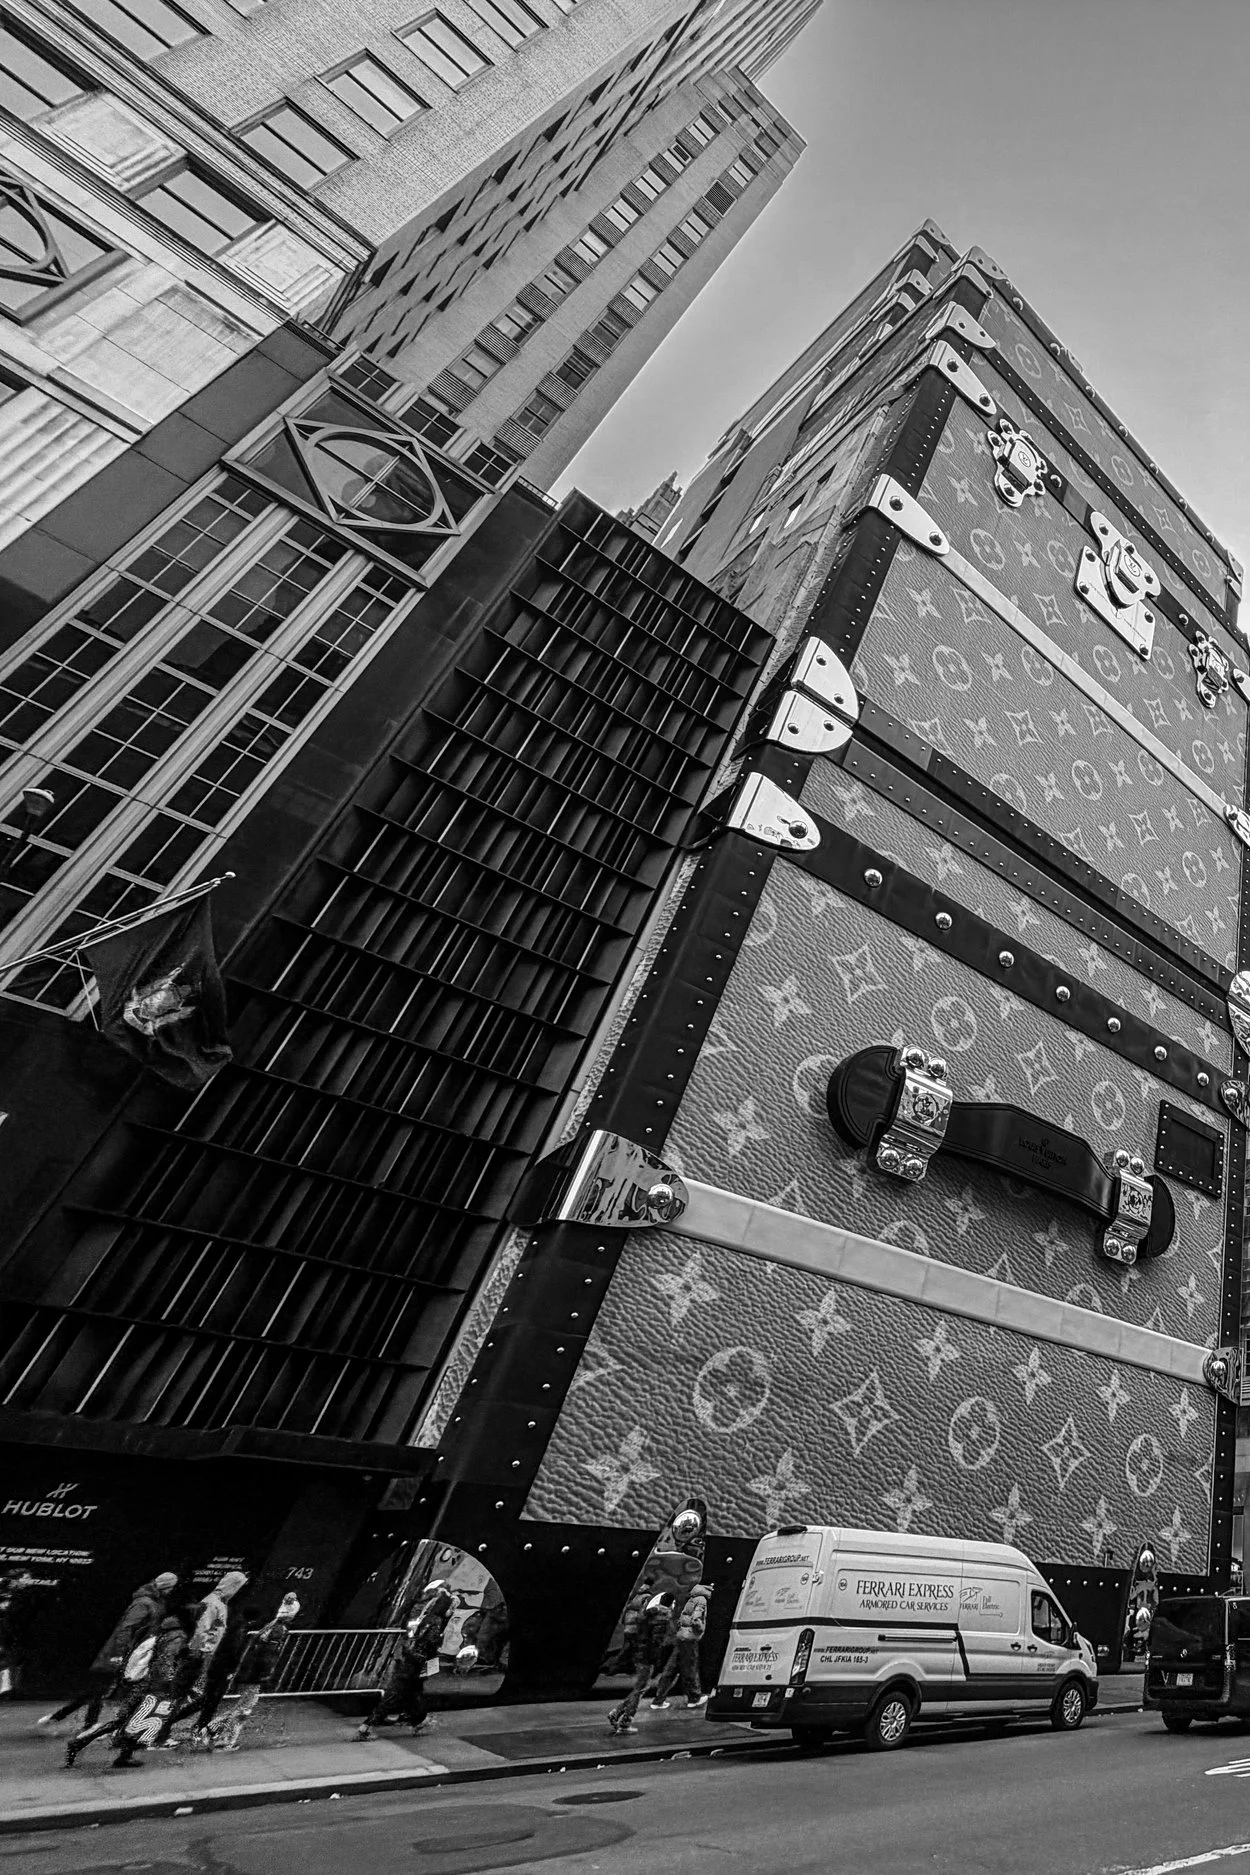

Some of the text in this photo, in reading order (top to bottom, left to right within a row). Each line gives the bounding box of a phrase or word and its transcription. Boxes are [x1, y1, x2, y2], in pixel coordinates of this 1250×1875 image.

[1, 1500, 98, 1519] HUBLOT
[285, 1567, 314, 1580] 743
[856, 1580, 906, 1599] FERRARI
[908, 1582, 955, 1600] EXPRESS
[859, 1599, 949, 1613] ARMORED CAR SERVICES
